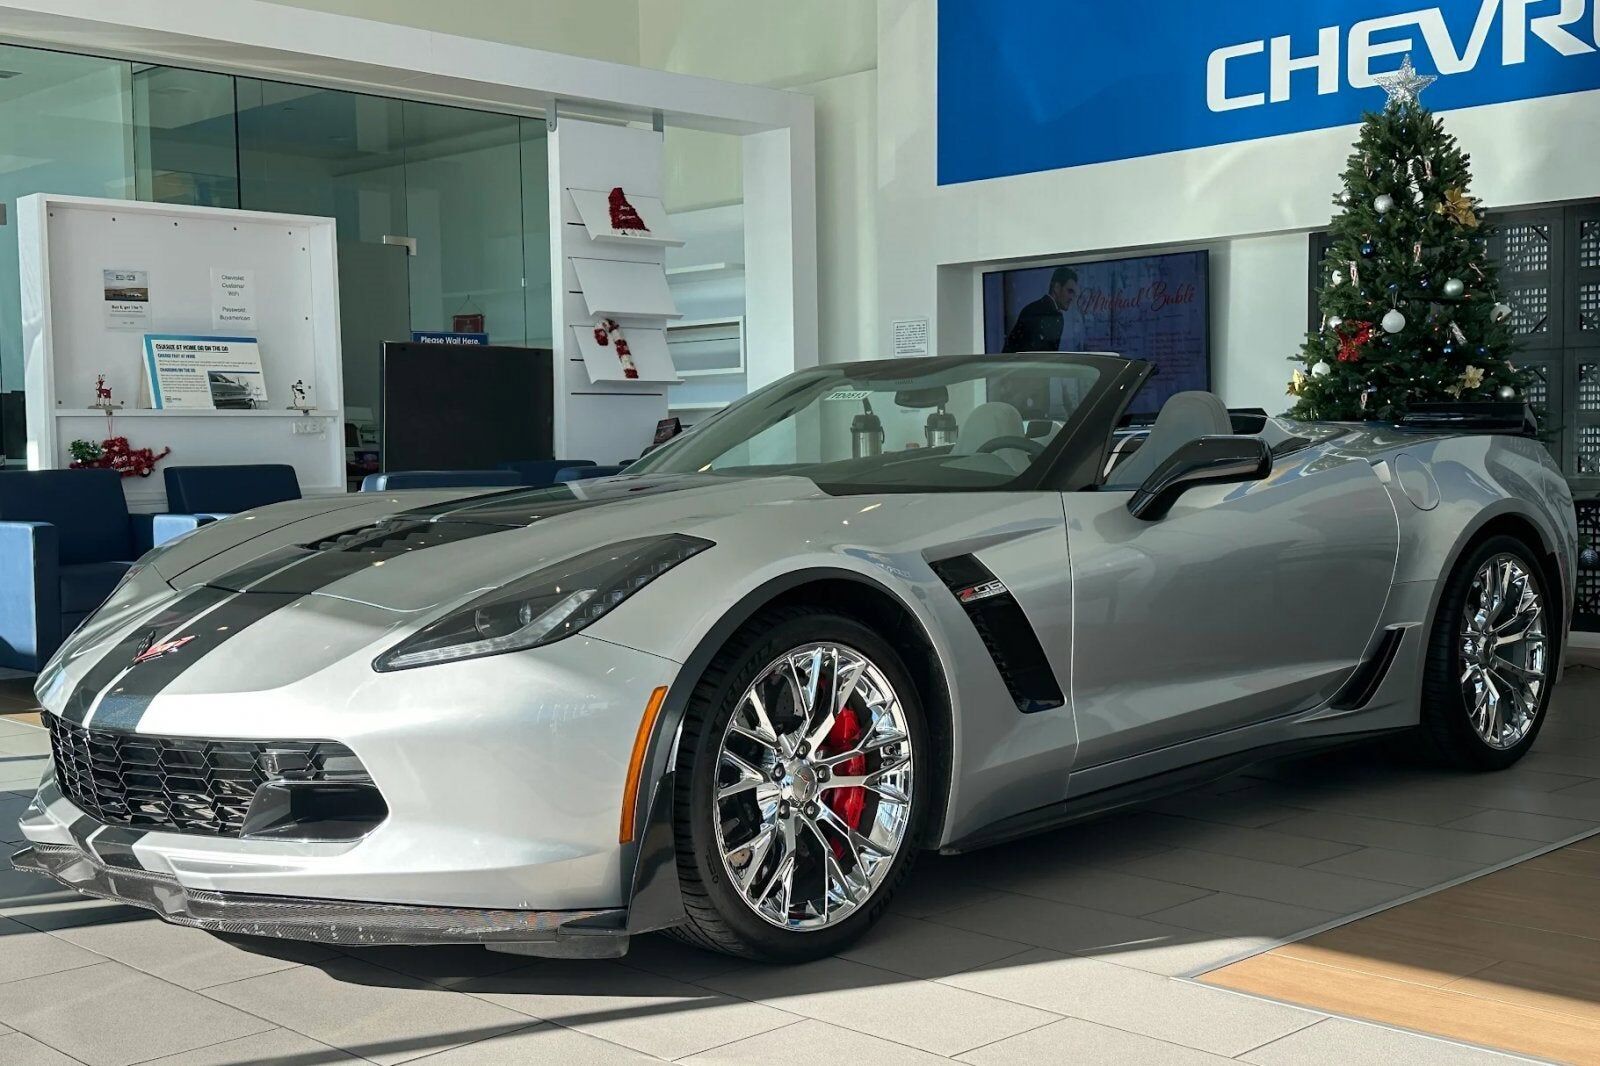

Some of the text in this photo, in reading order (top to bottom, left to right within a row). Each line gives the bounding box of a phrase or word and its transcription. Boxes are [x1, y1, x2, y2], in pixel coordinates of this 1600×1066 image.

[1206, 0, 1600, 113] CHEVR
[420, 336, 480, 345] Please Wait Here.
